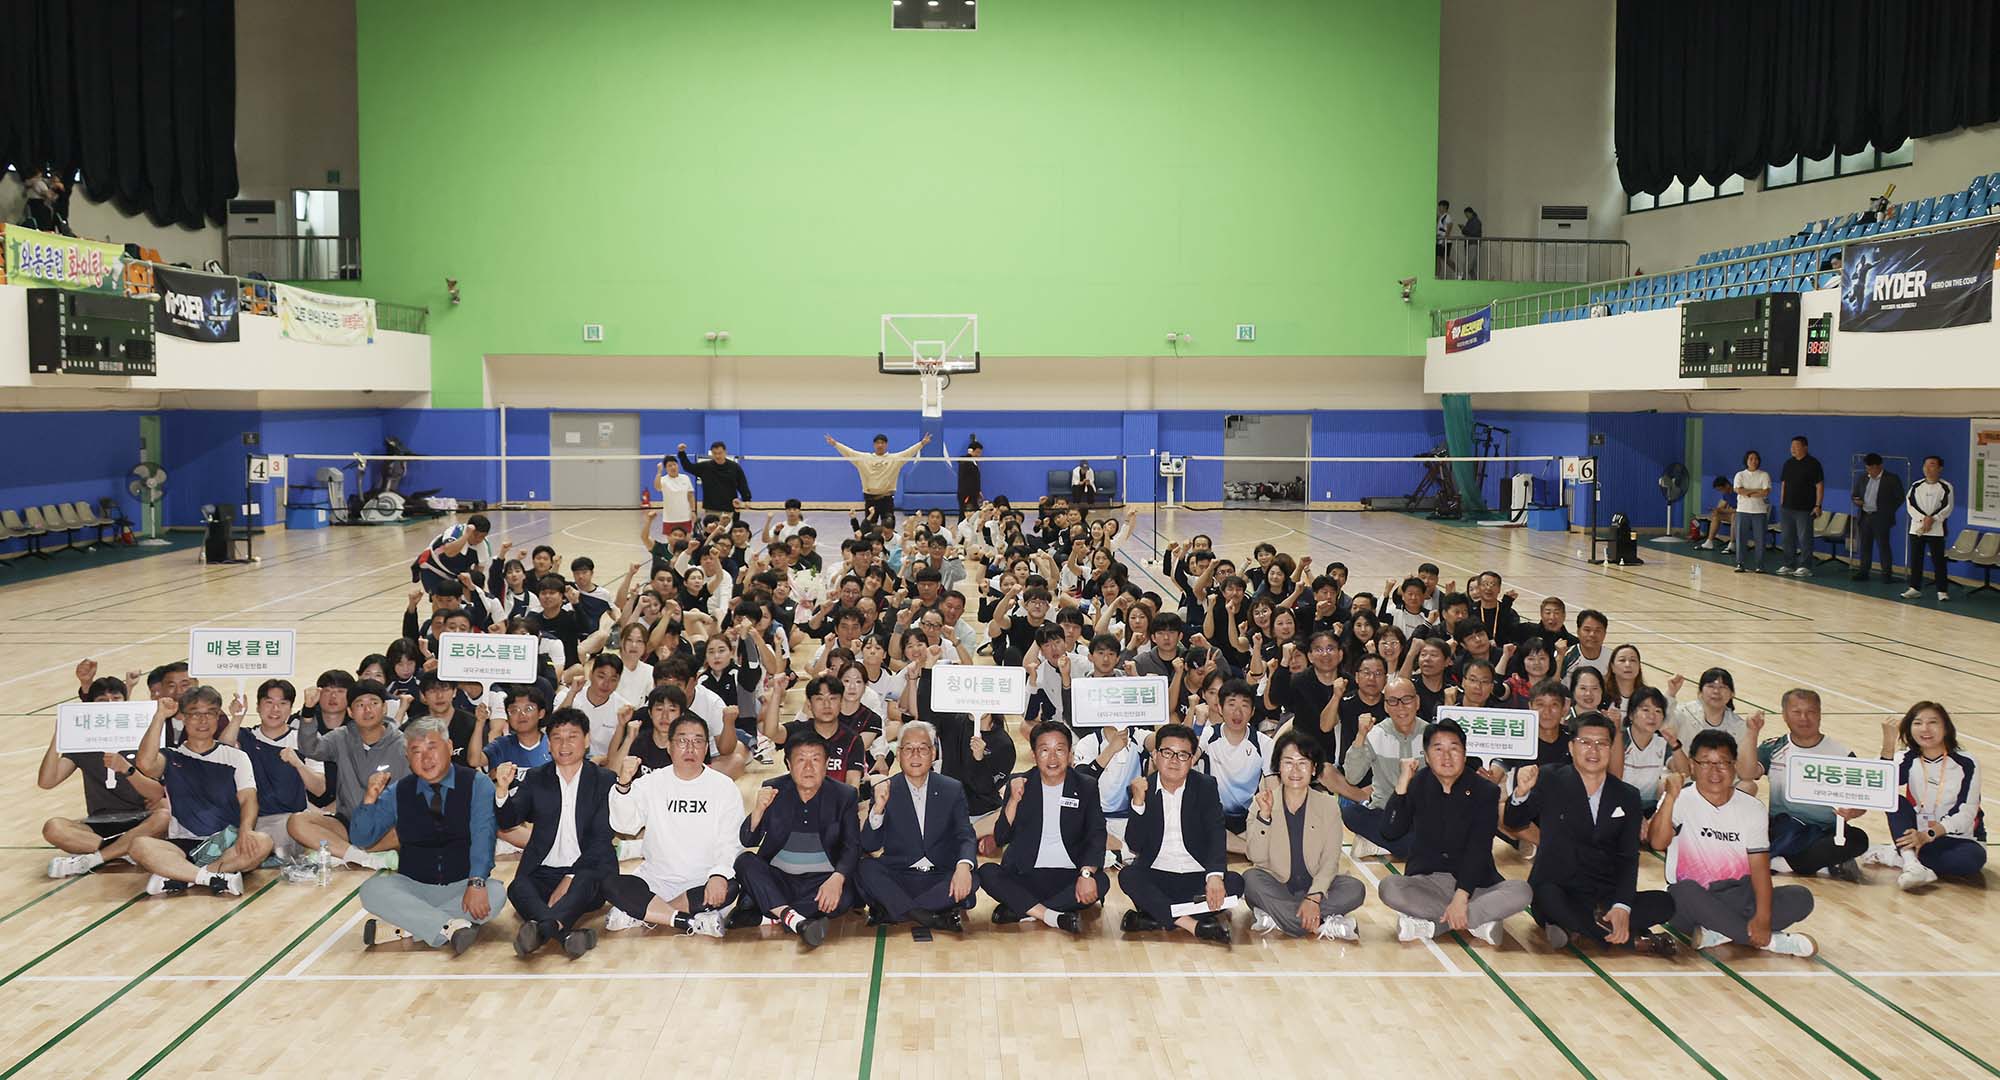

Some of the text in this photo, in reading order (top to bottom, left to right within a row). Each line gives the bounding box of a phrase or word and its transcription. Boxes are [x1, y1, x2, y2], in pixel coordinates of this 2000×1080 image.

[20, 240, 63, 279] 와동클럽
[1873, 270, 1927, 301] RYDER
[253, 461, 266, 478] 4
[273, 461, 280, 471] 3
[1568, 463, 1575, 472] 4
[1581, 461, 1592, 478] 6
[207, 640, 280, 656] 매봉클럽
[449, 643, 527, 660] 로하스클럽
[1803, 763, 1884, 788] 와동클럽
[1710, 828, 1741, 841] YONEX
